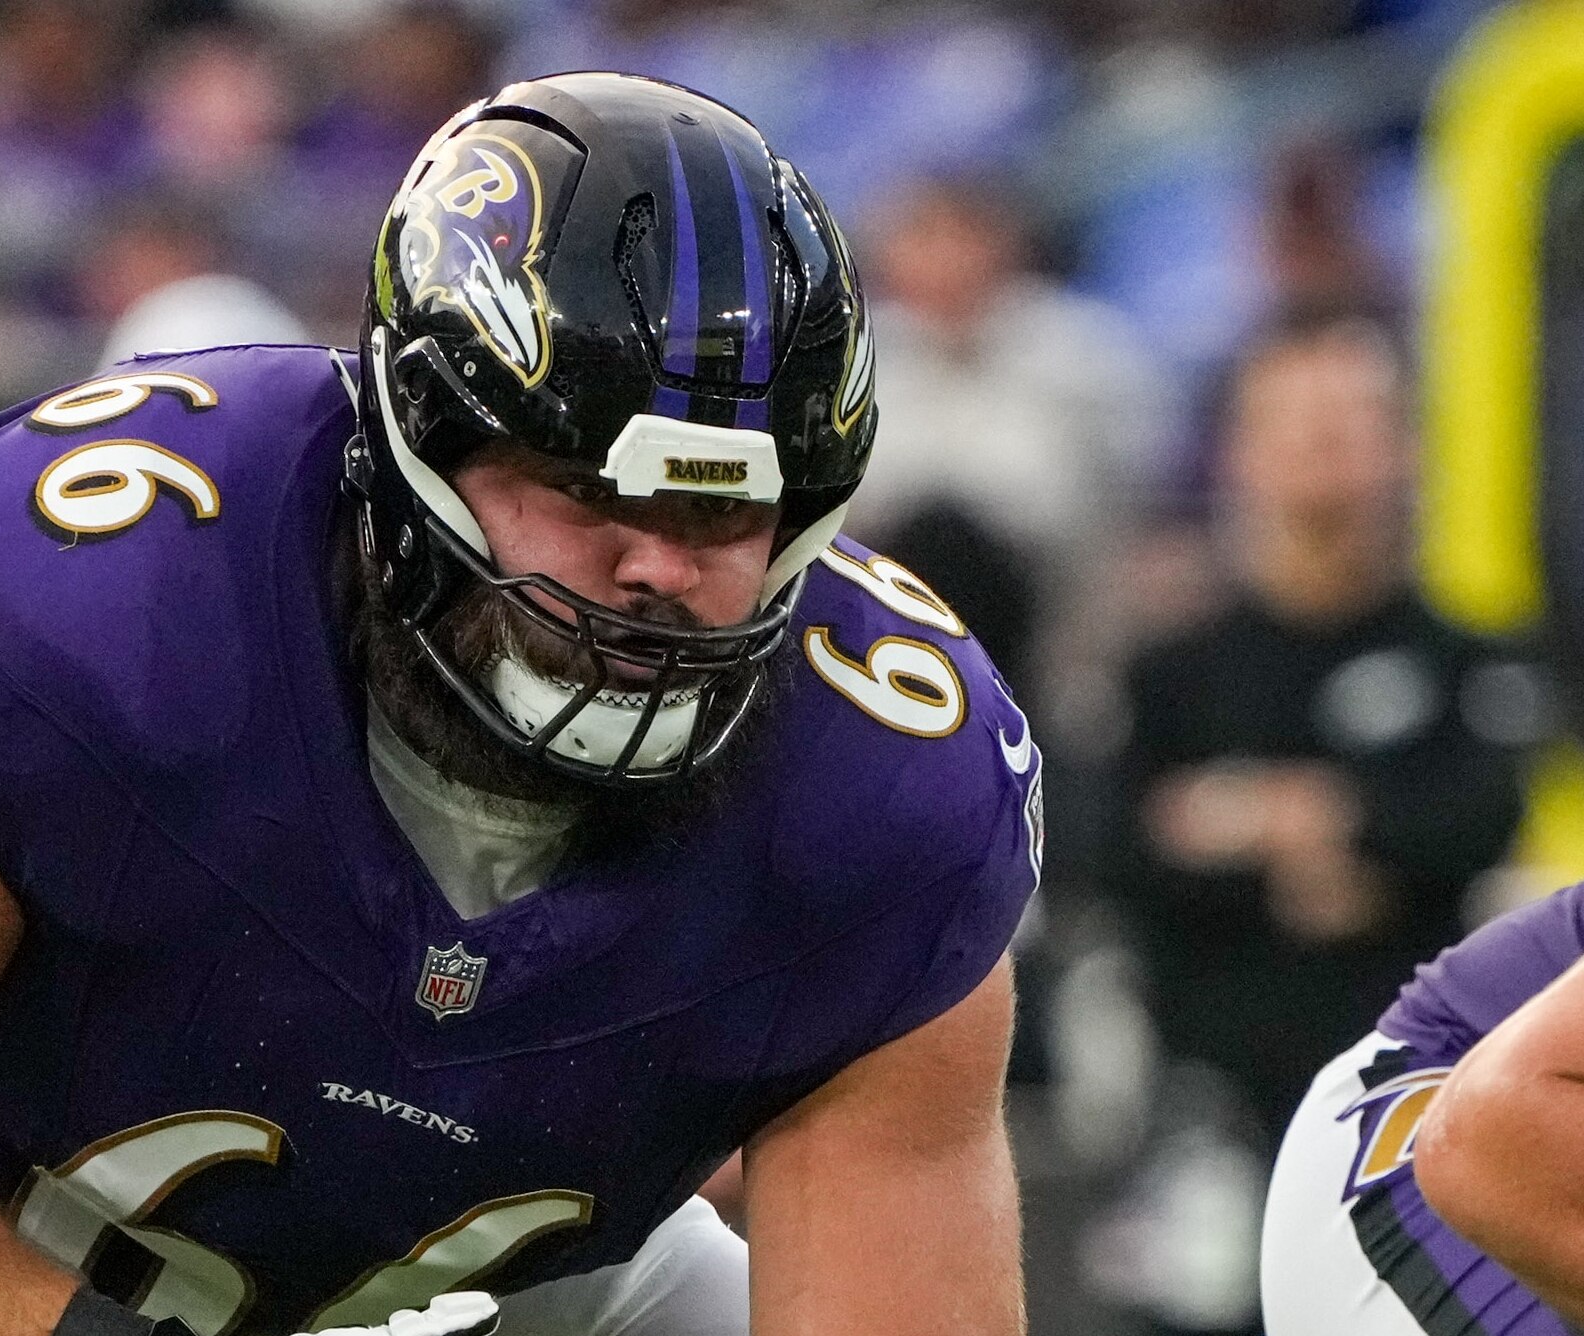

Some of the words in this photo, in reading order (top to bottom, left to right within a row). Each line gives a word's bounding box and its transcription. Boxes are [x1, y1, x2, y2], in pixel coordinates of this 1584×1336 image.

[27, 372, 221, 540] 66
[663, 456, 749, 485] RAVENS
[803, 546, 967, 738] 66
[425, 976, 466, 1007] NFL
[322, 1082, 476, 1143] RAVENS
